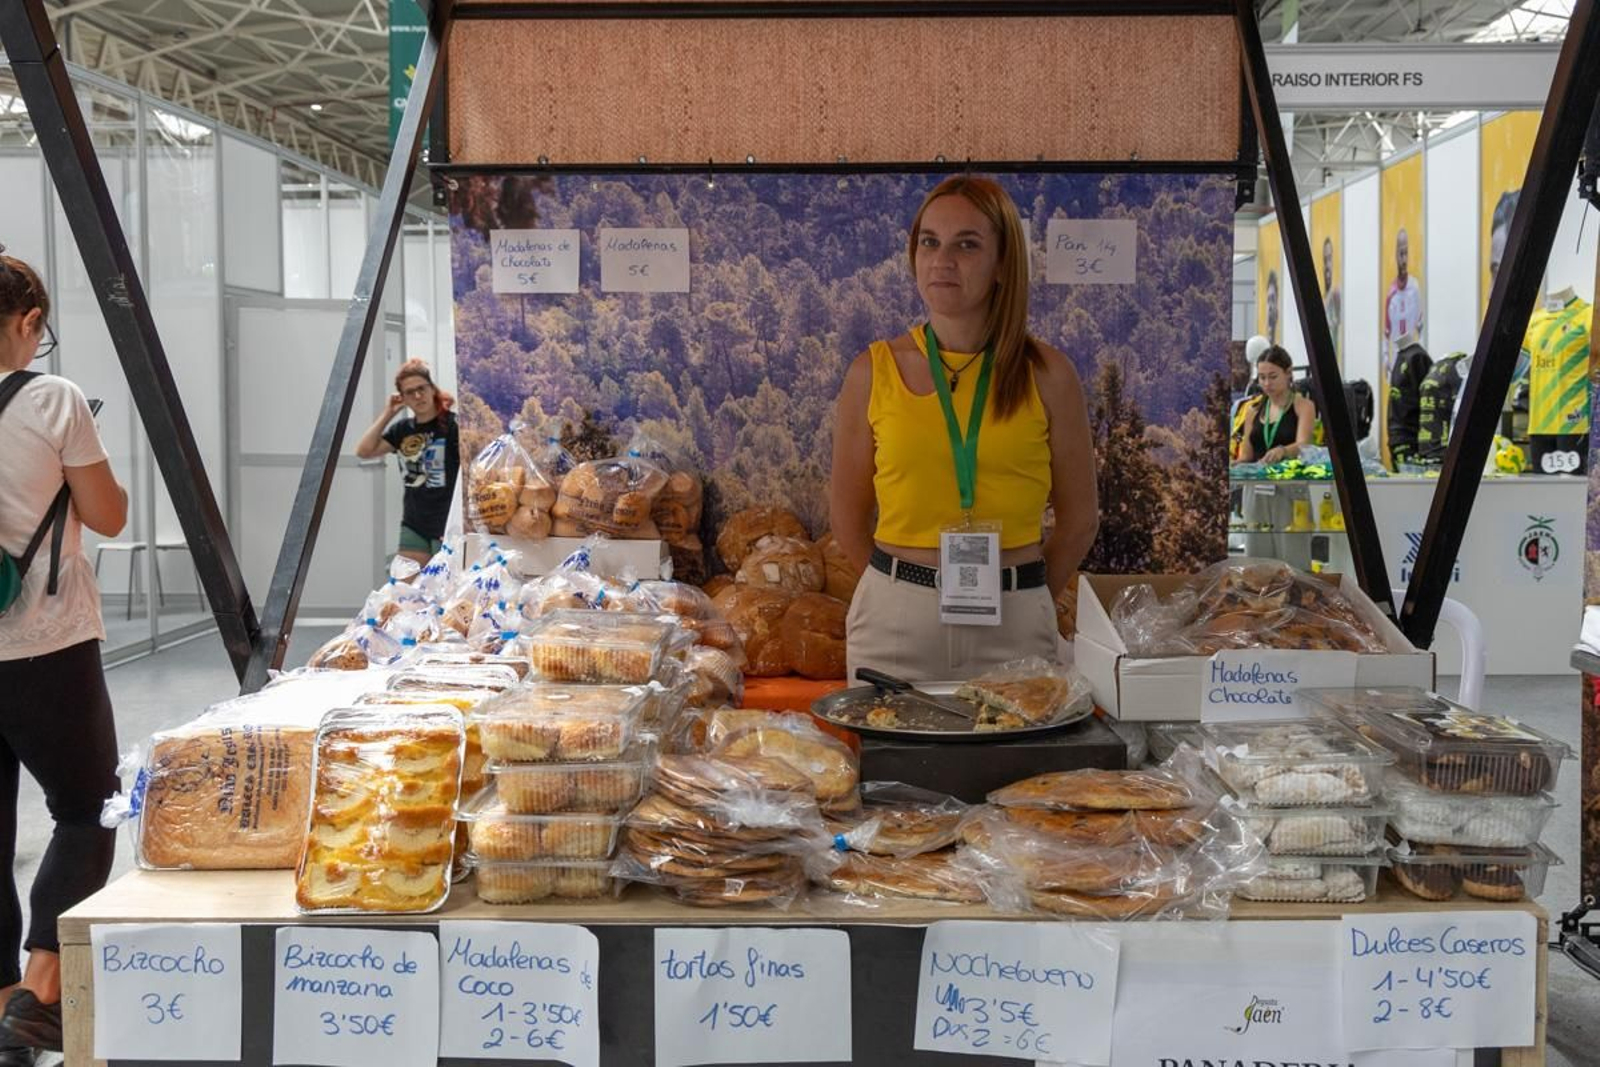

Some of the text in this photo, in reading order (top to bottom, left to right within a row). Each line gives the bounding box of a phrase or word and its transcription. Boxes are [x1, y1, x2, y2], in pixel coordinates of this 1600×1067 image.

[1325, 73, 1399, 87] INTERIOR
[1403, 72, 1423, 86] FS
[558, 239, 572, 251] de
[604, 237, 677, 252] Madalenas
[1056, 234, 1087, 250] Pan
[628, 264, 649, 276] 5€
[1075, 257, 1103, 275] 3€
[518, 272, 539, 285] 5€
[1549, 455, 1564, 468] 15
[1211, 660, 1298, 685] Madalenas
[1208, 686, 1292, 704] Chocolate
[1351, 926, 1526, 957] Dulces Caseros
[103, 944, 225, 974] Bizcocho
[284, 944, 417, 974] Bizcocho de
[447, 937, 571, 973] Madalenas
[661, 947, 805, 988] tortas finas
[286, 976, 394, 998] manzana
[141, 993, 185, 1024] 3€
[699, 1001, 777, 1030] 1'50€
[320, 1011, 396, 1036] 3'50€
